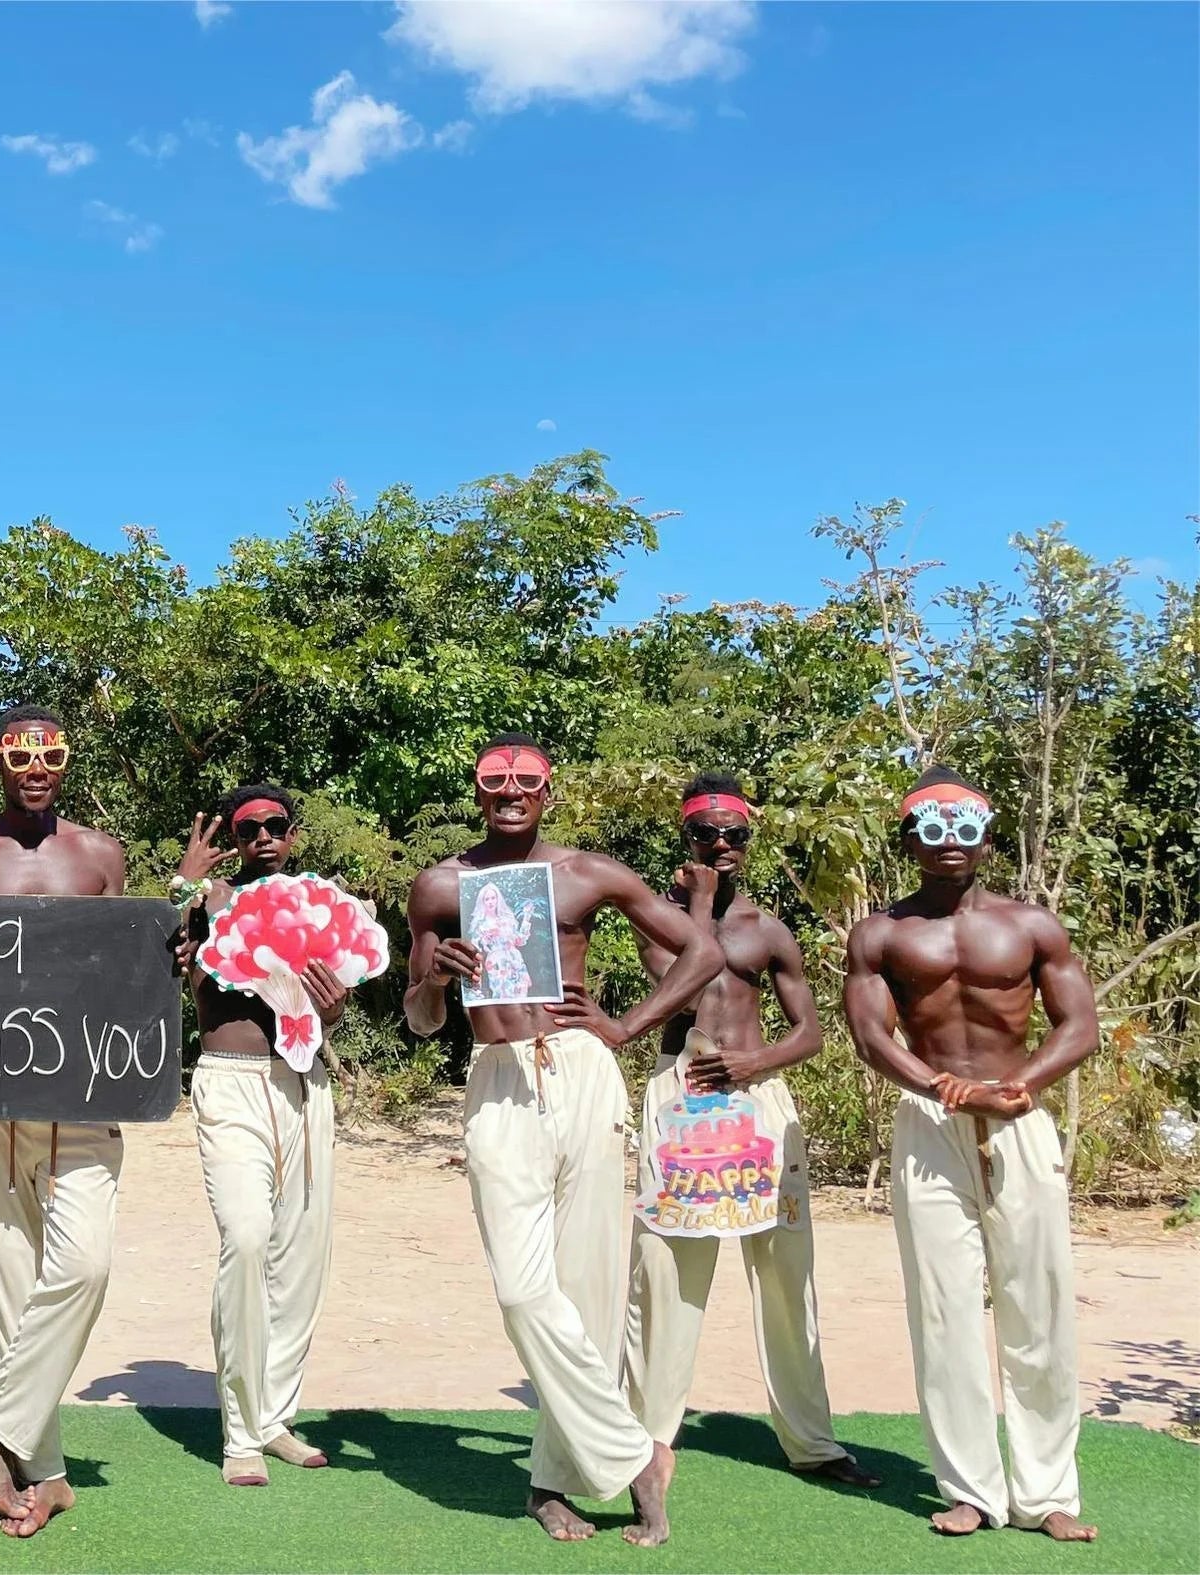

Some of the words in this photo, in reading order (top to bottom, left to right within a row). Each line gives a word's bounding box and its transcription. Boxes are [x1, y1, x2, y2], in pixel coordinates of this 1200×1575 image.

[81, 1014, 167, 1103] you
[668, 1163, 781, 1195] HAPPY
[655, 1194, 799, 1230] Birthday
